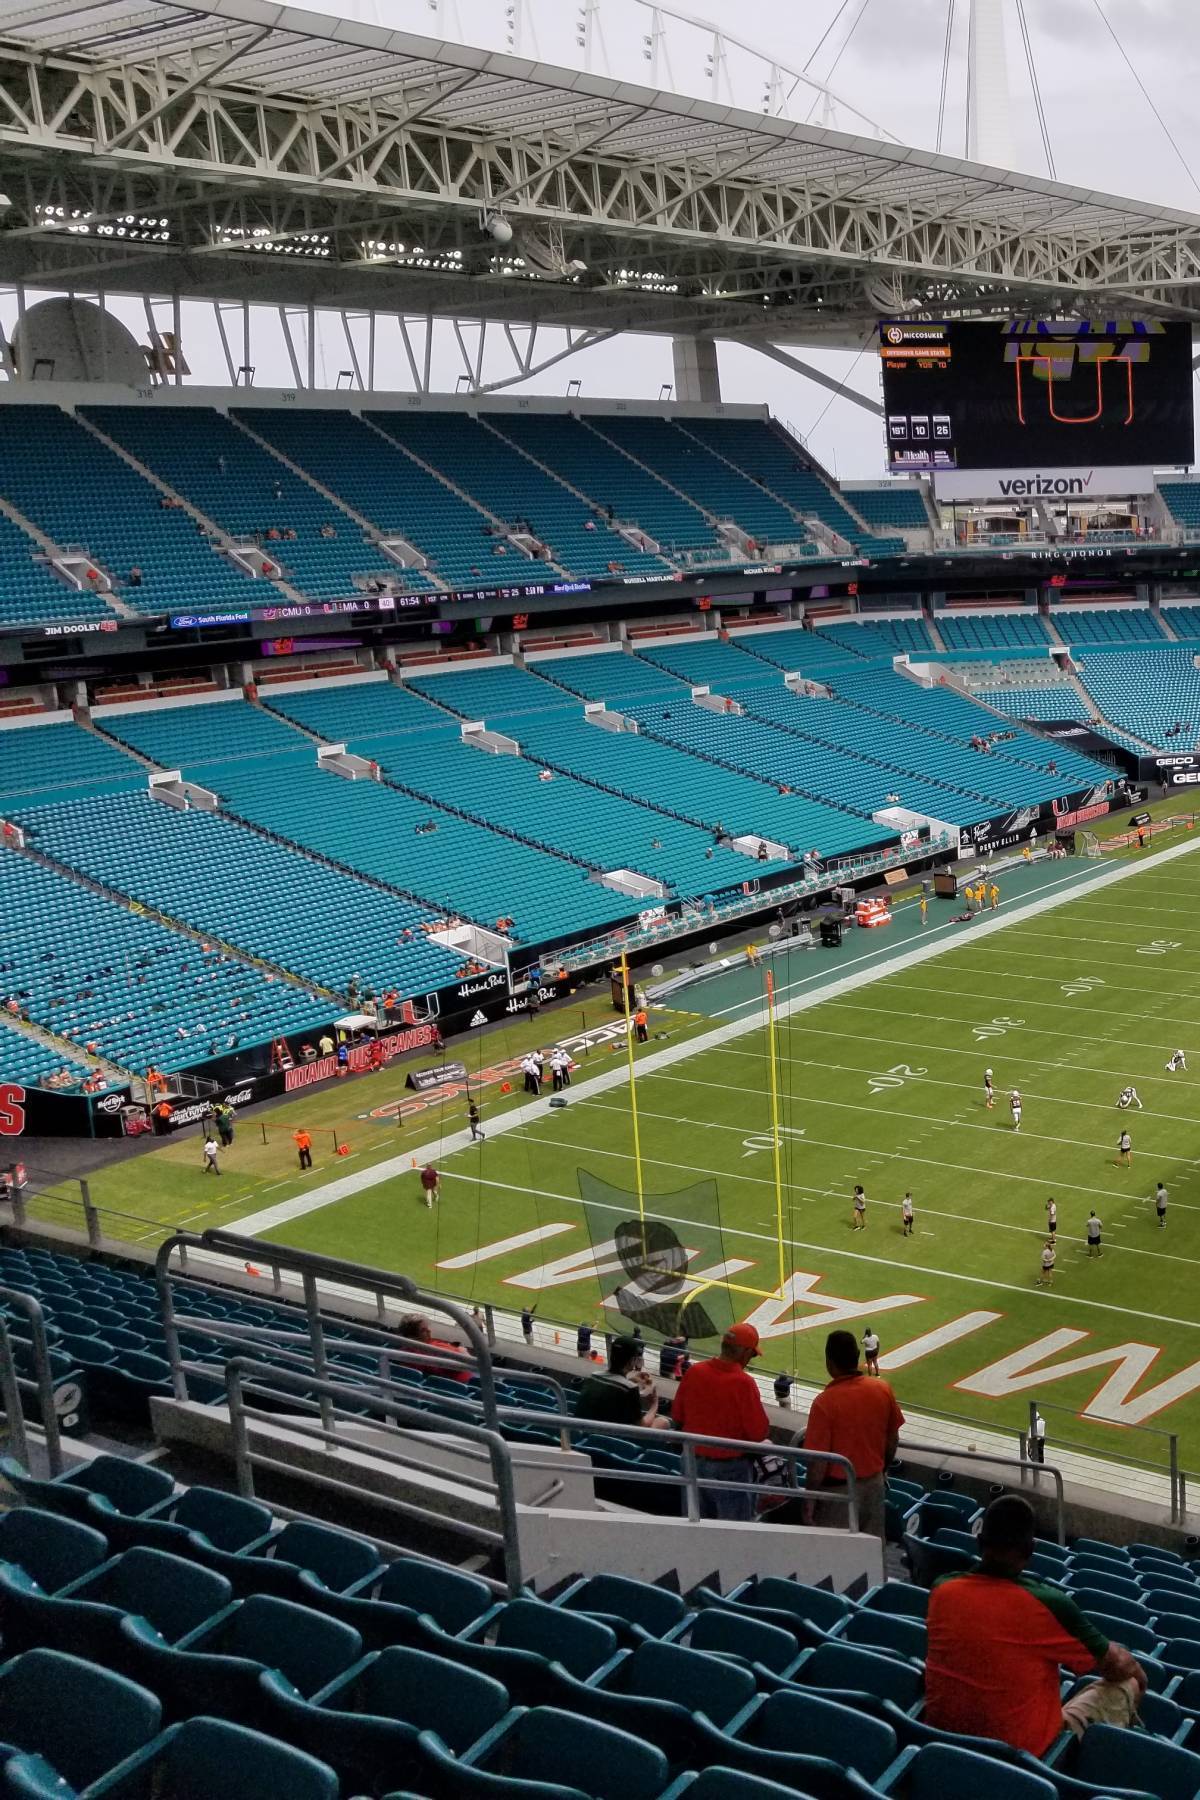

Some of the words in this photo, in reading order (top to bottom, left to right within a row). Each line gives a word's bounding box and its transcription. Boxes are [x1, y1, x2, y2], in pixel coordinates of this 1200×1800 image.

[903, 331, 944, 340] MICCOSUKEE
[886, 361, 907, 369] Player
[938, 361, 947, 369] TD
[891, 426, 905, 435] 1ST
[915, 426, 926, 436] 10
[999, 473, 1084, 497] verizon
[1031, 551, 1060, 559] RING
[1071, 549, 1113, 558] HONOR
[477, 591, 485, 599] 10
[511, 588, 519, 597] 25
[343, 601, 359, 612] MIA
[364, 600, 370, 609] 0
[400, 596, 420, 606] 61:54
[281, 606, 302, 617] CMU
[305, 606, 311, 615] 0
[198, 616, 216, 624] South
[216, 613, 236, 622] Florida
[236, 612, 248, 621] Ford
[45, 627, 62, 636] JIM
[64, 622, 101, 634] DOOLEY
[1156, 756, 1194, 766] GEICO
[979, 840, 1000, 853] PERRY
[1001, 834, 1020, 846] ELLIS
[488, 974, 506, 987] Park
[537, 987, 557, 1002] Park
[402, 992, 440, 1025] U
[470, 1017, 489, 1027] adidas
[972, 1016, 1026, 1038] 30
[285, 1054, 338, 1092] MIAMI
[868, 1063, 928, 1089] 20
[97, 1098, 112, 1109] Hard
[111, 1094, 126, 1105] Rock
[224, 1089, 253, 1104] Coca-Cola
[742, 1124, 806, 1152] 10
